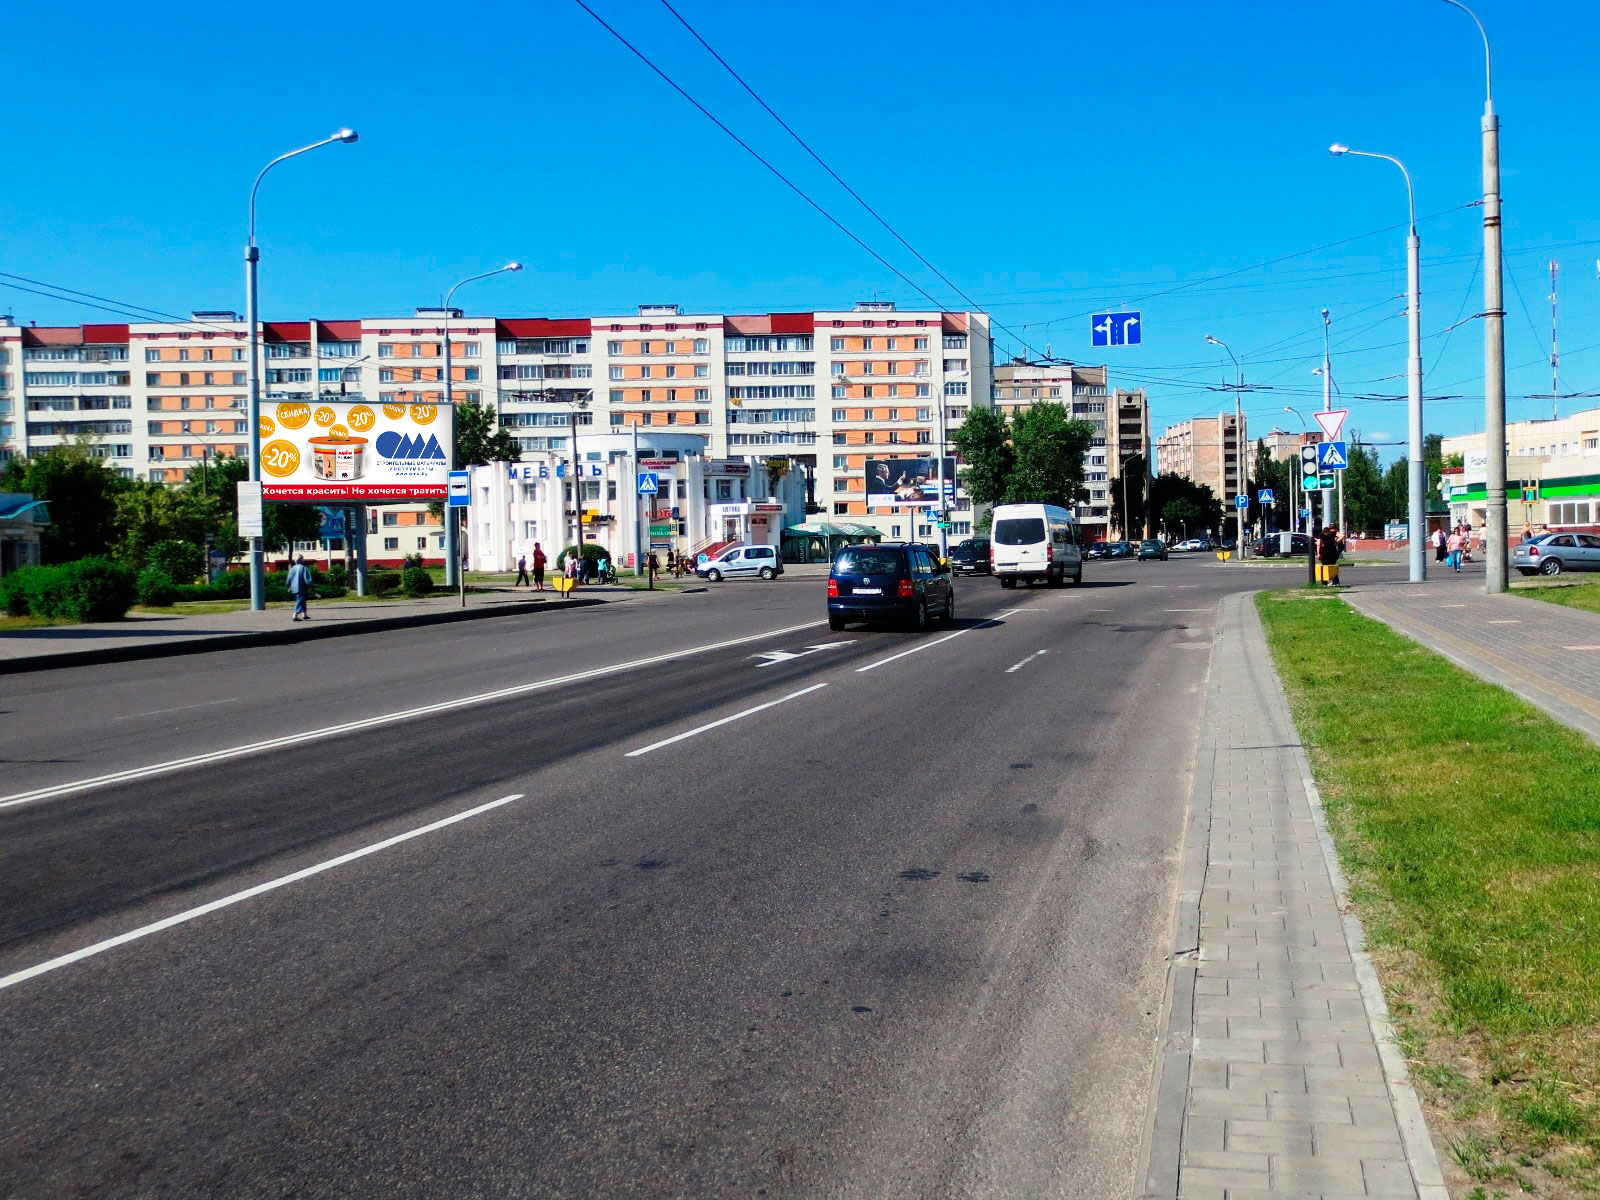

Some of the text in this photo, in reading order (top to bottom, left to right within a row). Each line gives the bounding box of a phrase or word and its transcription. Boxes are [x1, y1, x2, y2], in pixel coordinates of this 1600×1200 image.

[280, 407, 308, 418] СКИДКА
[264, 447, 297, 468] -20%
[262, 487, 304, 495] Хочется
[306, 487, 349, 496] красить!
[351, 487, 365, 495] Не
[408, 487, 448, 497] тратить!
